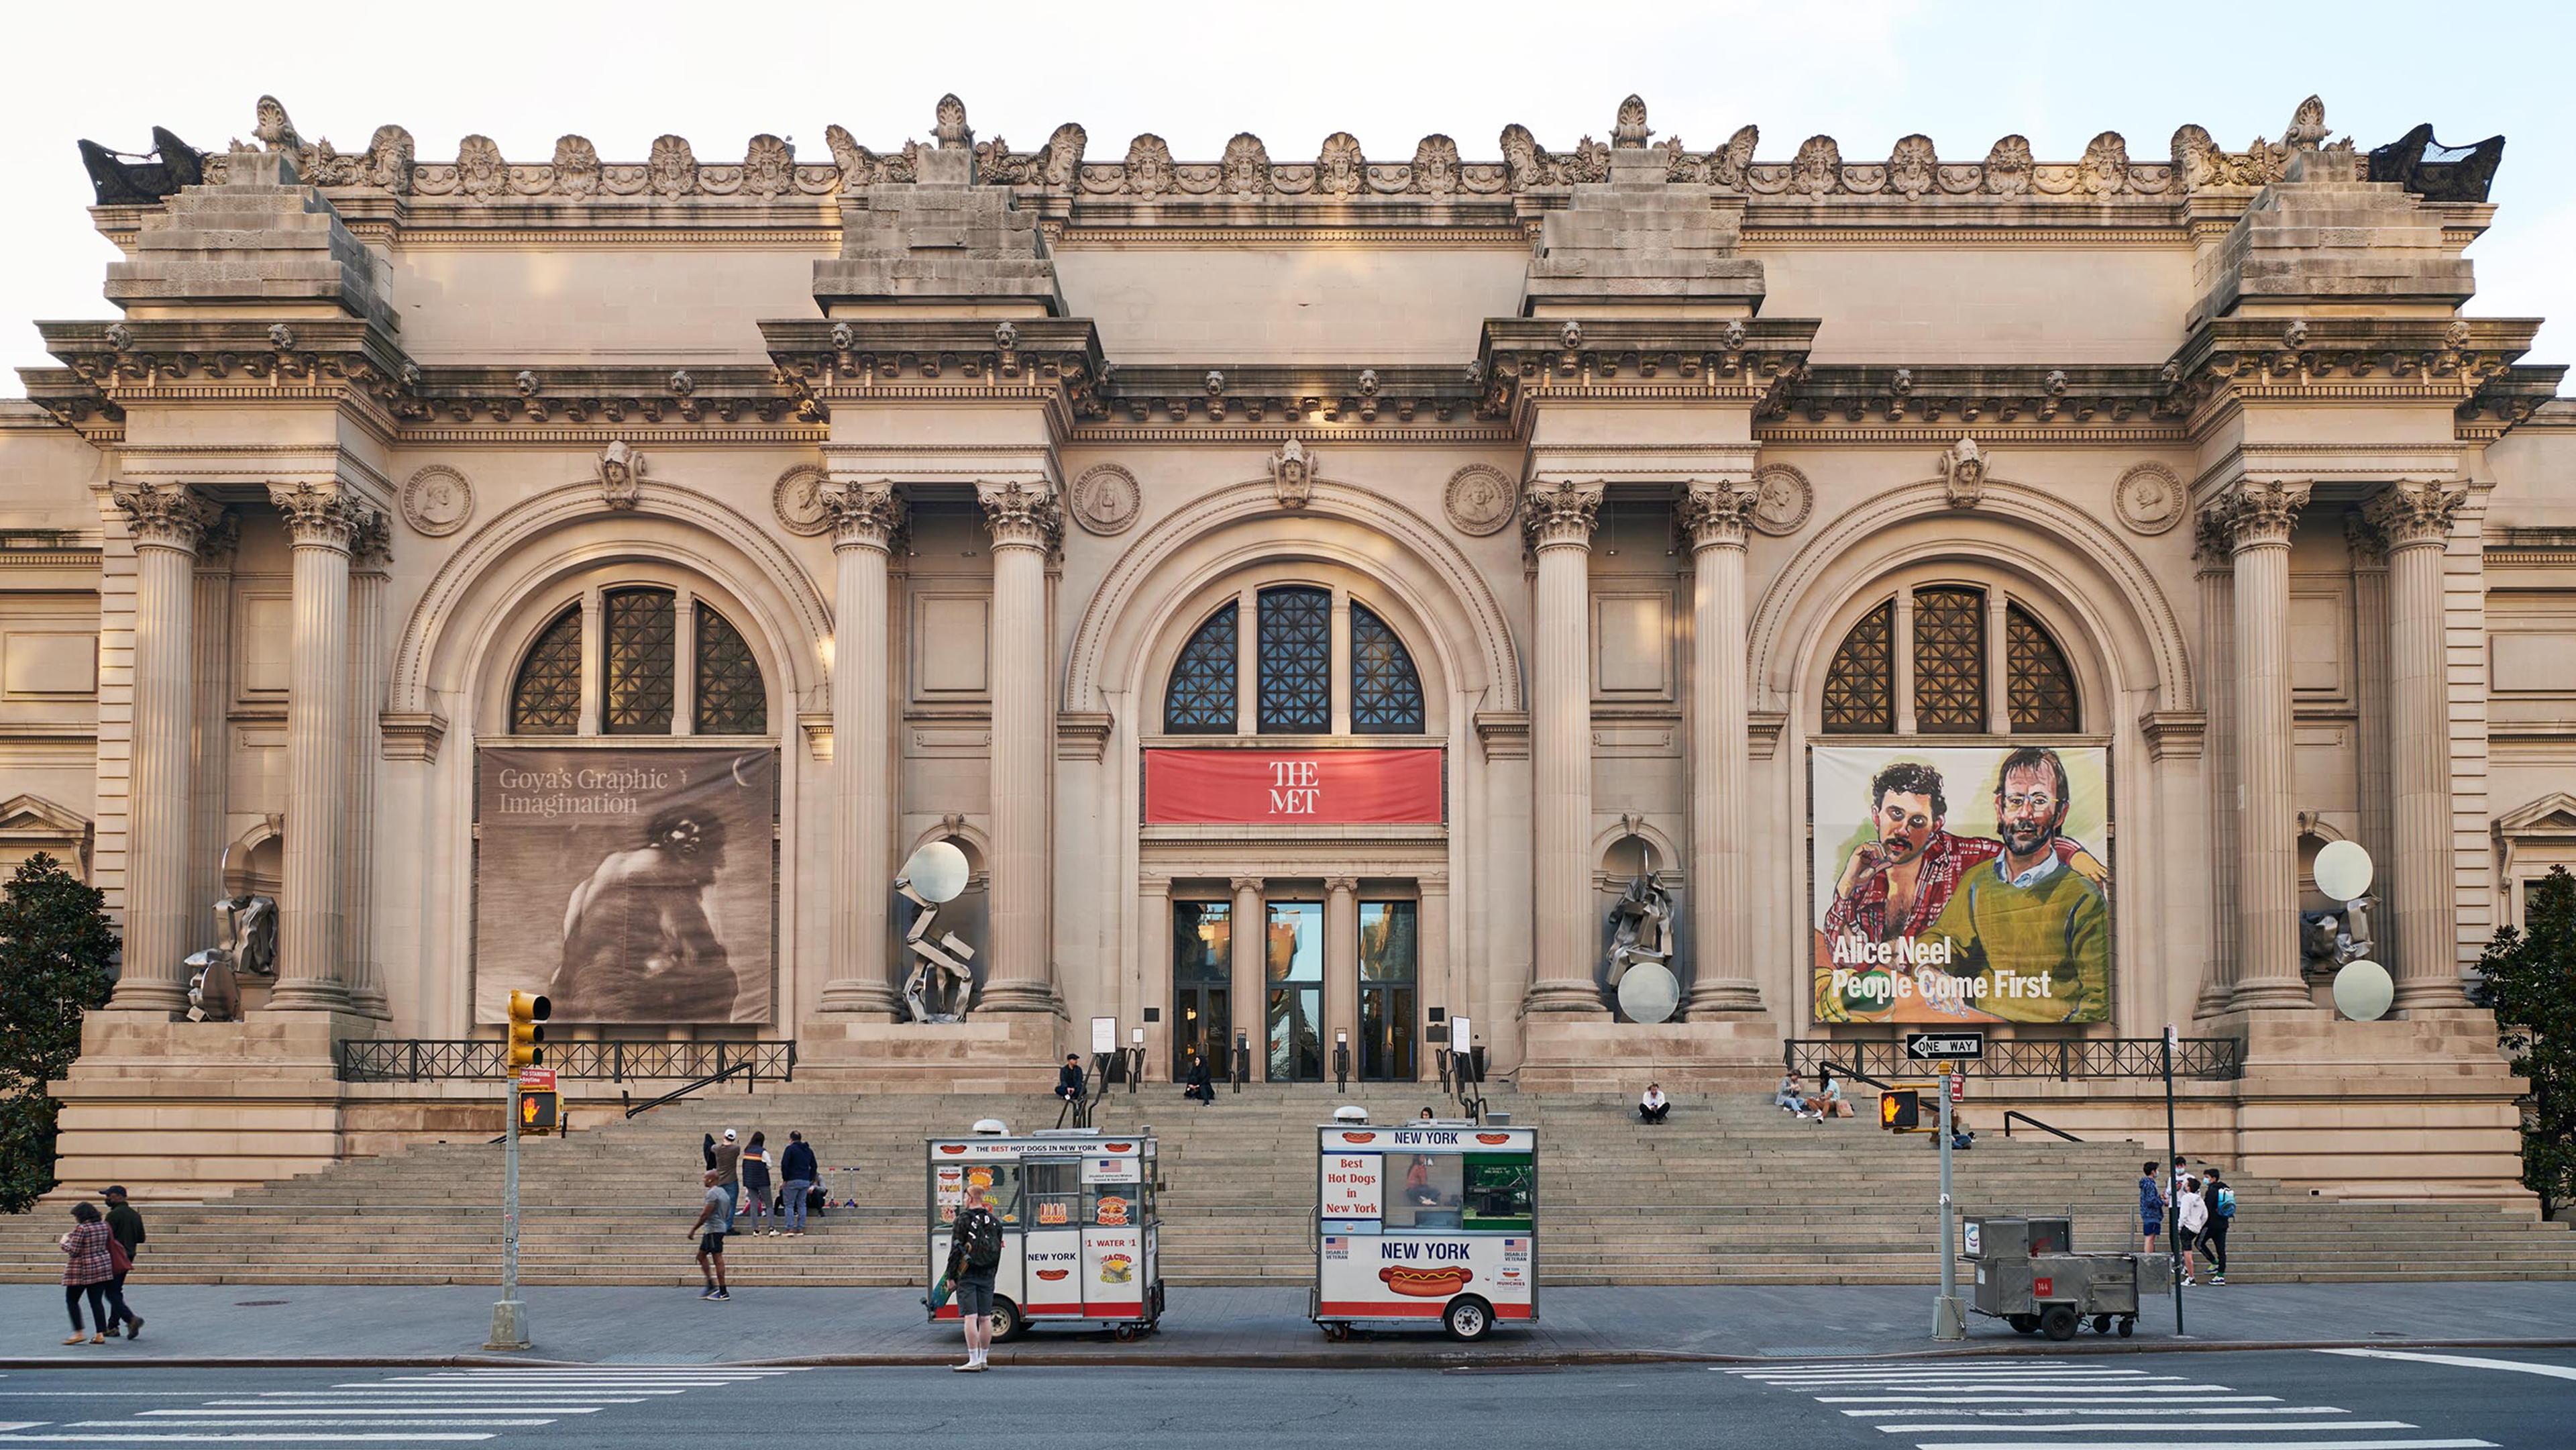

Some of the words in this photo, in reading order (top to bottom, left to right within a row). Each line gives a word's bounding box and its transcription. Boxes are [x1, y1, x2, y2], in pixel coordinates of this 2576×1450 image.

[1269, 761, 1319, 787] THE
[499, 768, 572, 794] Goya's
[578, 768, 668, 794] Graphic
[499, 793, 637, 818] Imagination
[1268, 789, 1320, 814] MET
[1833, 936, 1892, 964] Alice
[1899, 936, 1951, 964] Neel
[1833, 970, 1911, 1004] People
[1919, 970, 1988, 998] Come
[1994, 970, 2052, 998] First
[1919, 1041, 1939, 1051] ONE
[1950, 1041, 1973, 1051] WAY
[1395, 1132, 1421, 1144] NEW
[1426, 1132, 1458, 1144] YORK
[1340, 1159, 1362, 1168] Best
[1328, 1174, 1346, 1183] Hot
[1350, 1174, 1376, 1185] Dogs
[1346, 1188, 1356, 1198] in
[1326, 1204, 1350, 1213] New
[1354, 1204, 1377, 1213] York
[1098, 1215, 1127, 1225] DOG
[1382, 1243, 1419, 1259] NEW
[1426, 1243, 1470, 1259] YORK
[2038, 1283, 2048, 1291] 144
